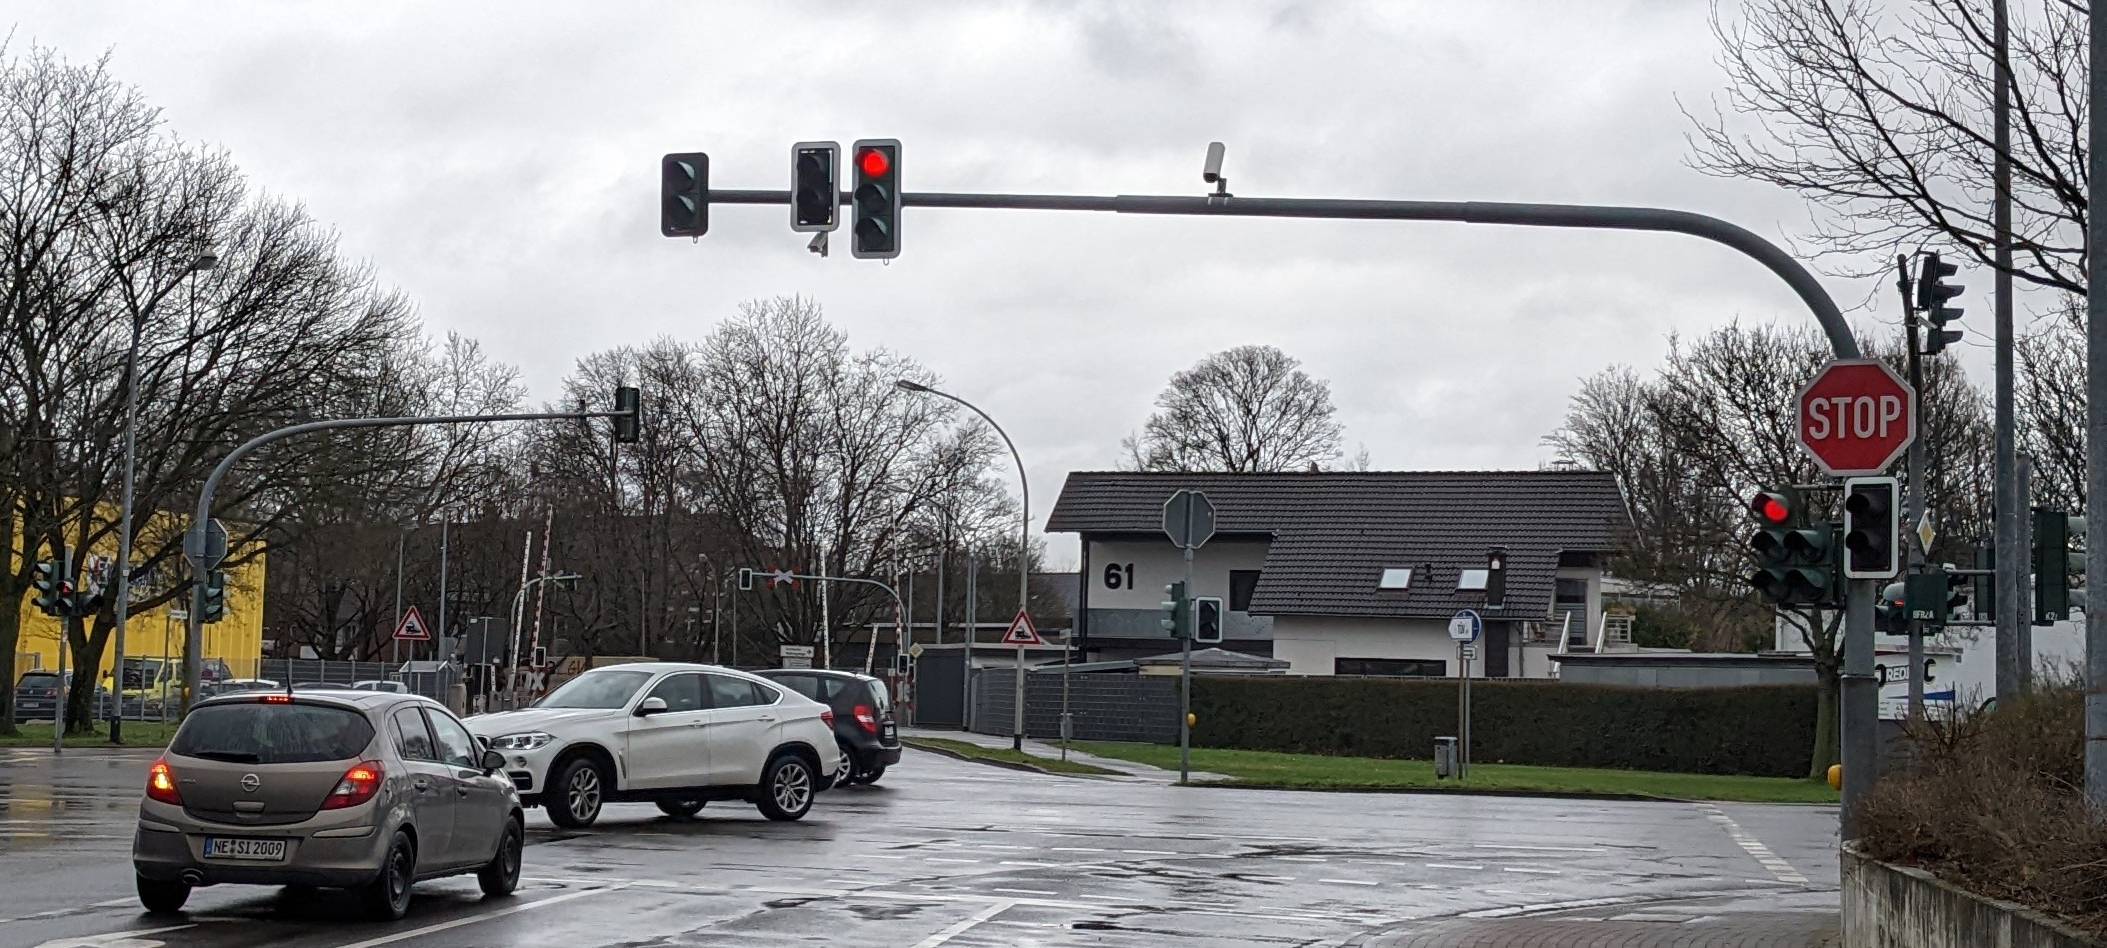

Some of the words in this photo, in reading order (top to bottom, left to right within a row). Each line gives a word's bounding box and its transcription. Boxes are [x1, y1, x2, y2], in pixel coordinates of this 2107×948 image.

[1808, 395, 1901, 441] STOP
[1103, 562, 1134, 590] 61
[213, 840, 229, 854] NE
[237, 841, 250, 855] SI
[253, 841, 282, 856] 2009
